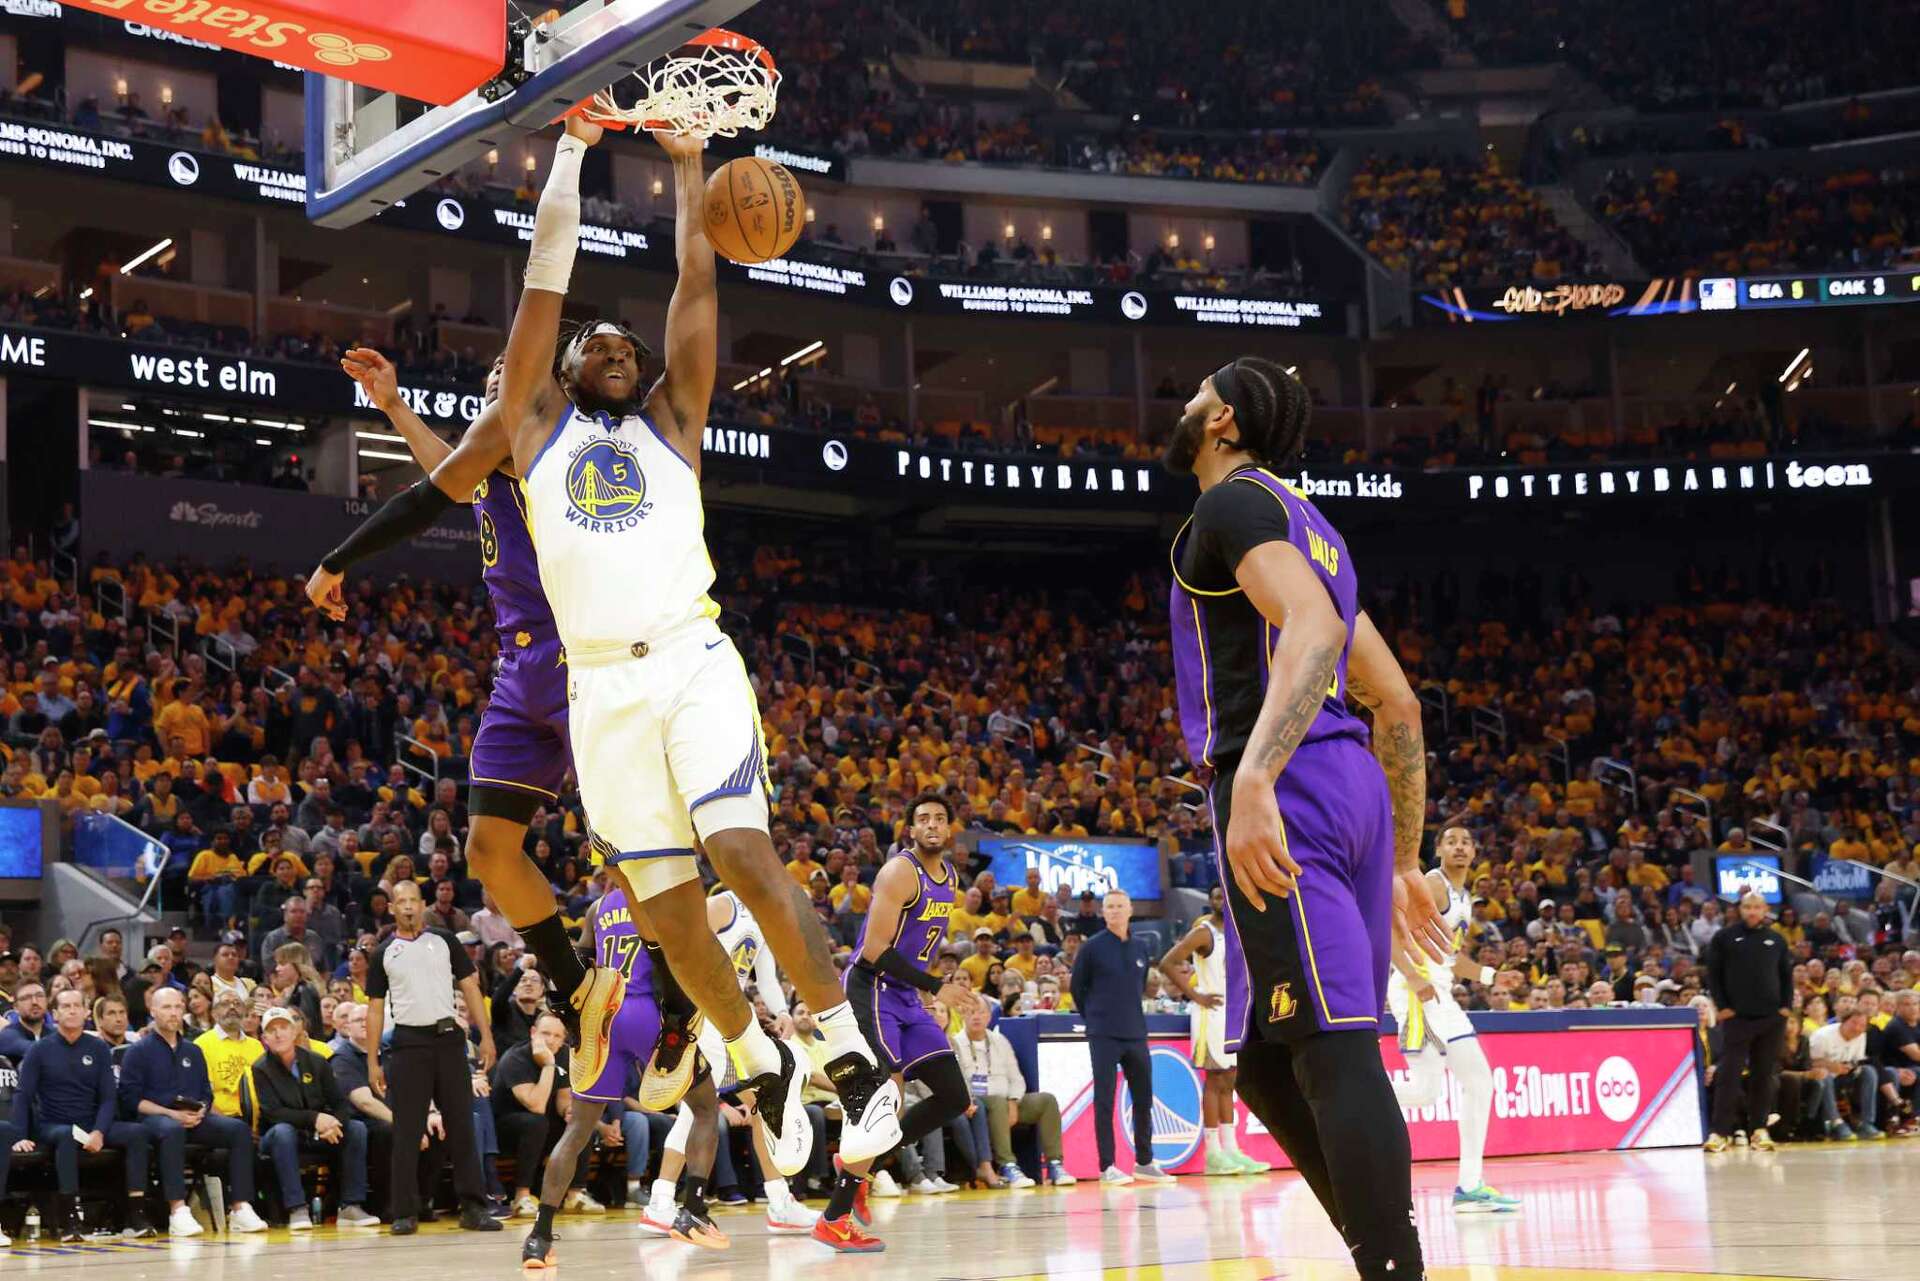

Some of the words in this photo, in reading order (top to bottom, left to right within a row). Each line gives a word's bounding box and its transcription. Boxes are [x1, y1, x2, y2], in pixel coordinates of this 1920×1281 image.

[30, 145, 47, 158] TO
[49, 148, 106, 169] BUSINESS
[754, 144, 832, 173] ticketmaster
[748, 268, 790, 285] BUSINESS
[805, 278, 846, 294] BUSINESS
[1749, 283, 1784, 299] SEA
[1829, 279, 1866, 295] OAK
[962, 299, 1008, 311] BUSINESS
[1010, 301, 1024, 312] TO
[1025, 302, 1071, 314] BUSINESS
[1196, 311, 1240, 324] BUSINESS
[1242, 313, 1255, 324] TO
[1256, 314, 1300, 327] BUSINESS
[131, 354, 209, 388] west
[219, 361, 276, 396] elm
[353, 381, 431, 415] MRK
[433, 392, 457, 418] &
[612, 463, 628, 481] 5
[1301, 471, 1352, 496] barn
[1356, 473, 1402, 498] kids
[1785, 460, 1873, 488] teen
[198, 503, 262, 528] Sports
[345, 501, 369, 515] 104
[565, 501, 654, 534] WARRIORS
[599, 907, 632, 931] SCHR
[917, 925, 943, 961] 7
[603, 934, 642, 982] 17
[1569, 1071, 1591, 1115] ET
[1600, 1077, 1635, 1097] abc
